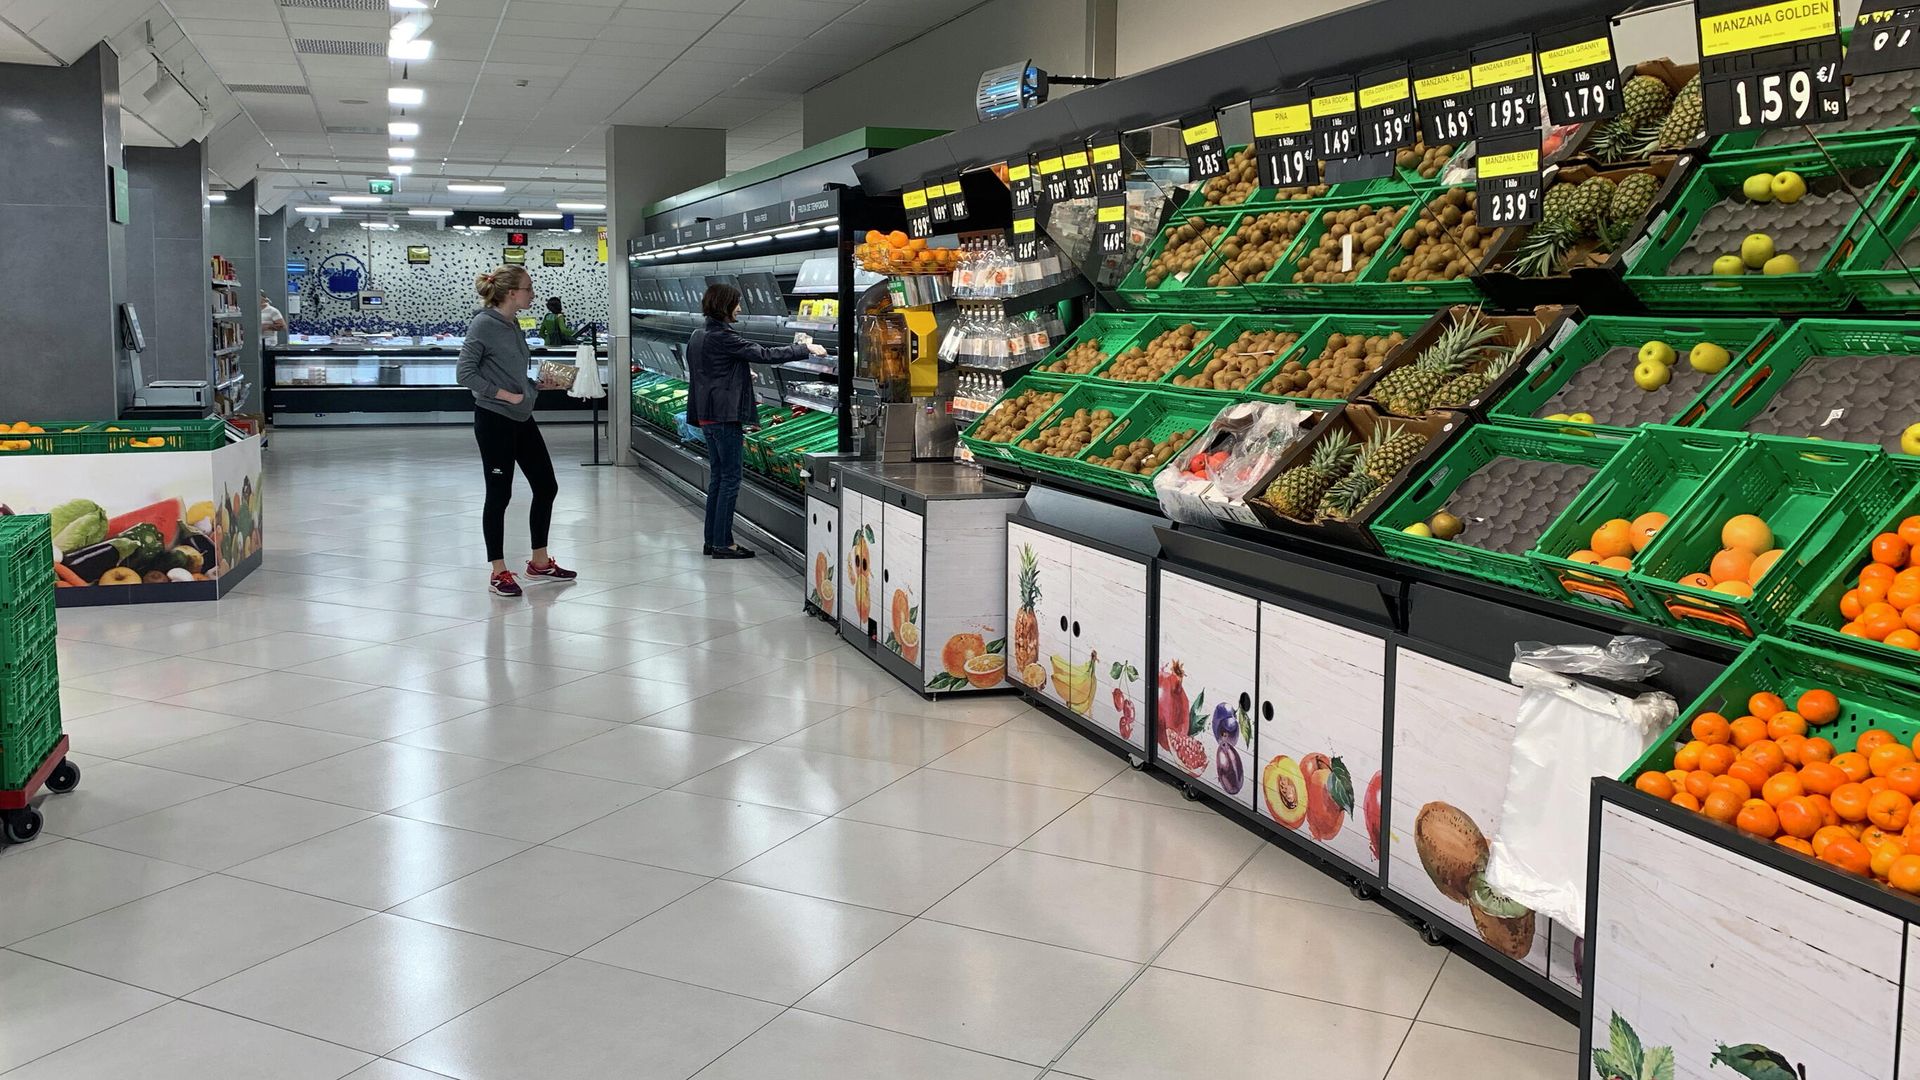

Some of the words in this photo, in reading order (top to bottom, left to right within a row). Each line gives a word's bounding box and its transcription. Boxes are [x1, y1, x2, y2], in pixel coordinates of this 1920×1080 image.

[1713, 12, 1772, 34] MANZANA
[1775, 1, 1829, 21] GOLDEN
[1548, 47, 1575, 59] MANZANA
[1576, 41, 1600, 53] GRANNY
[1479, 63, 1503, 73] MANZANA
[1420, 76, 1449, 88] MANZANA
[1451, 73, 1465, 82] FUJI
[1823, 98, 1839, 115] kg
[1485, 155, 1516, 166] MANZANA
[1517, 151, 1534, 162] ENVY
